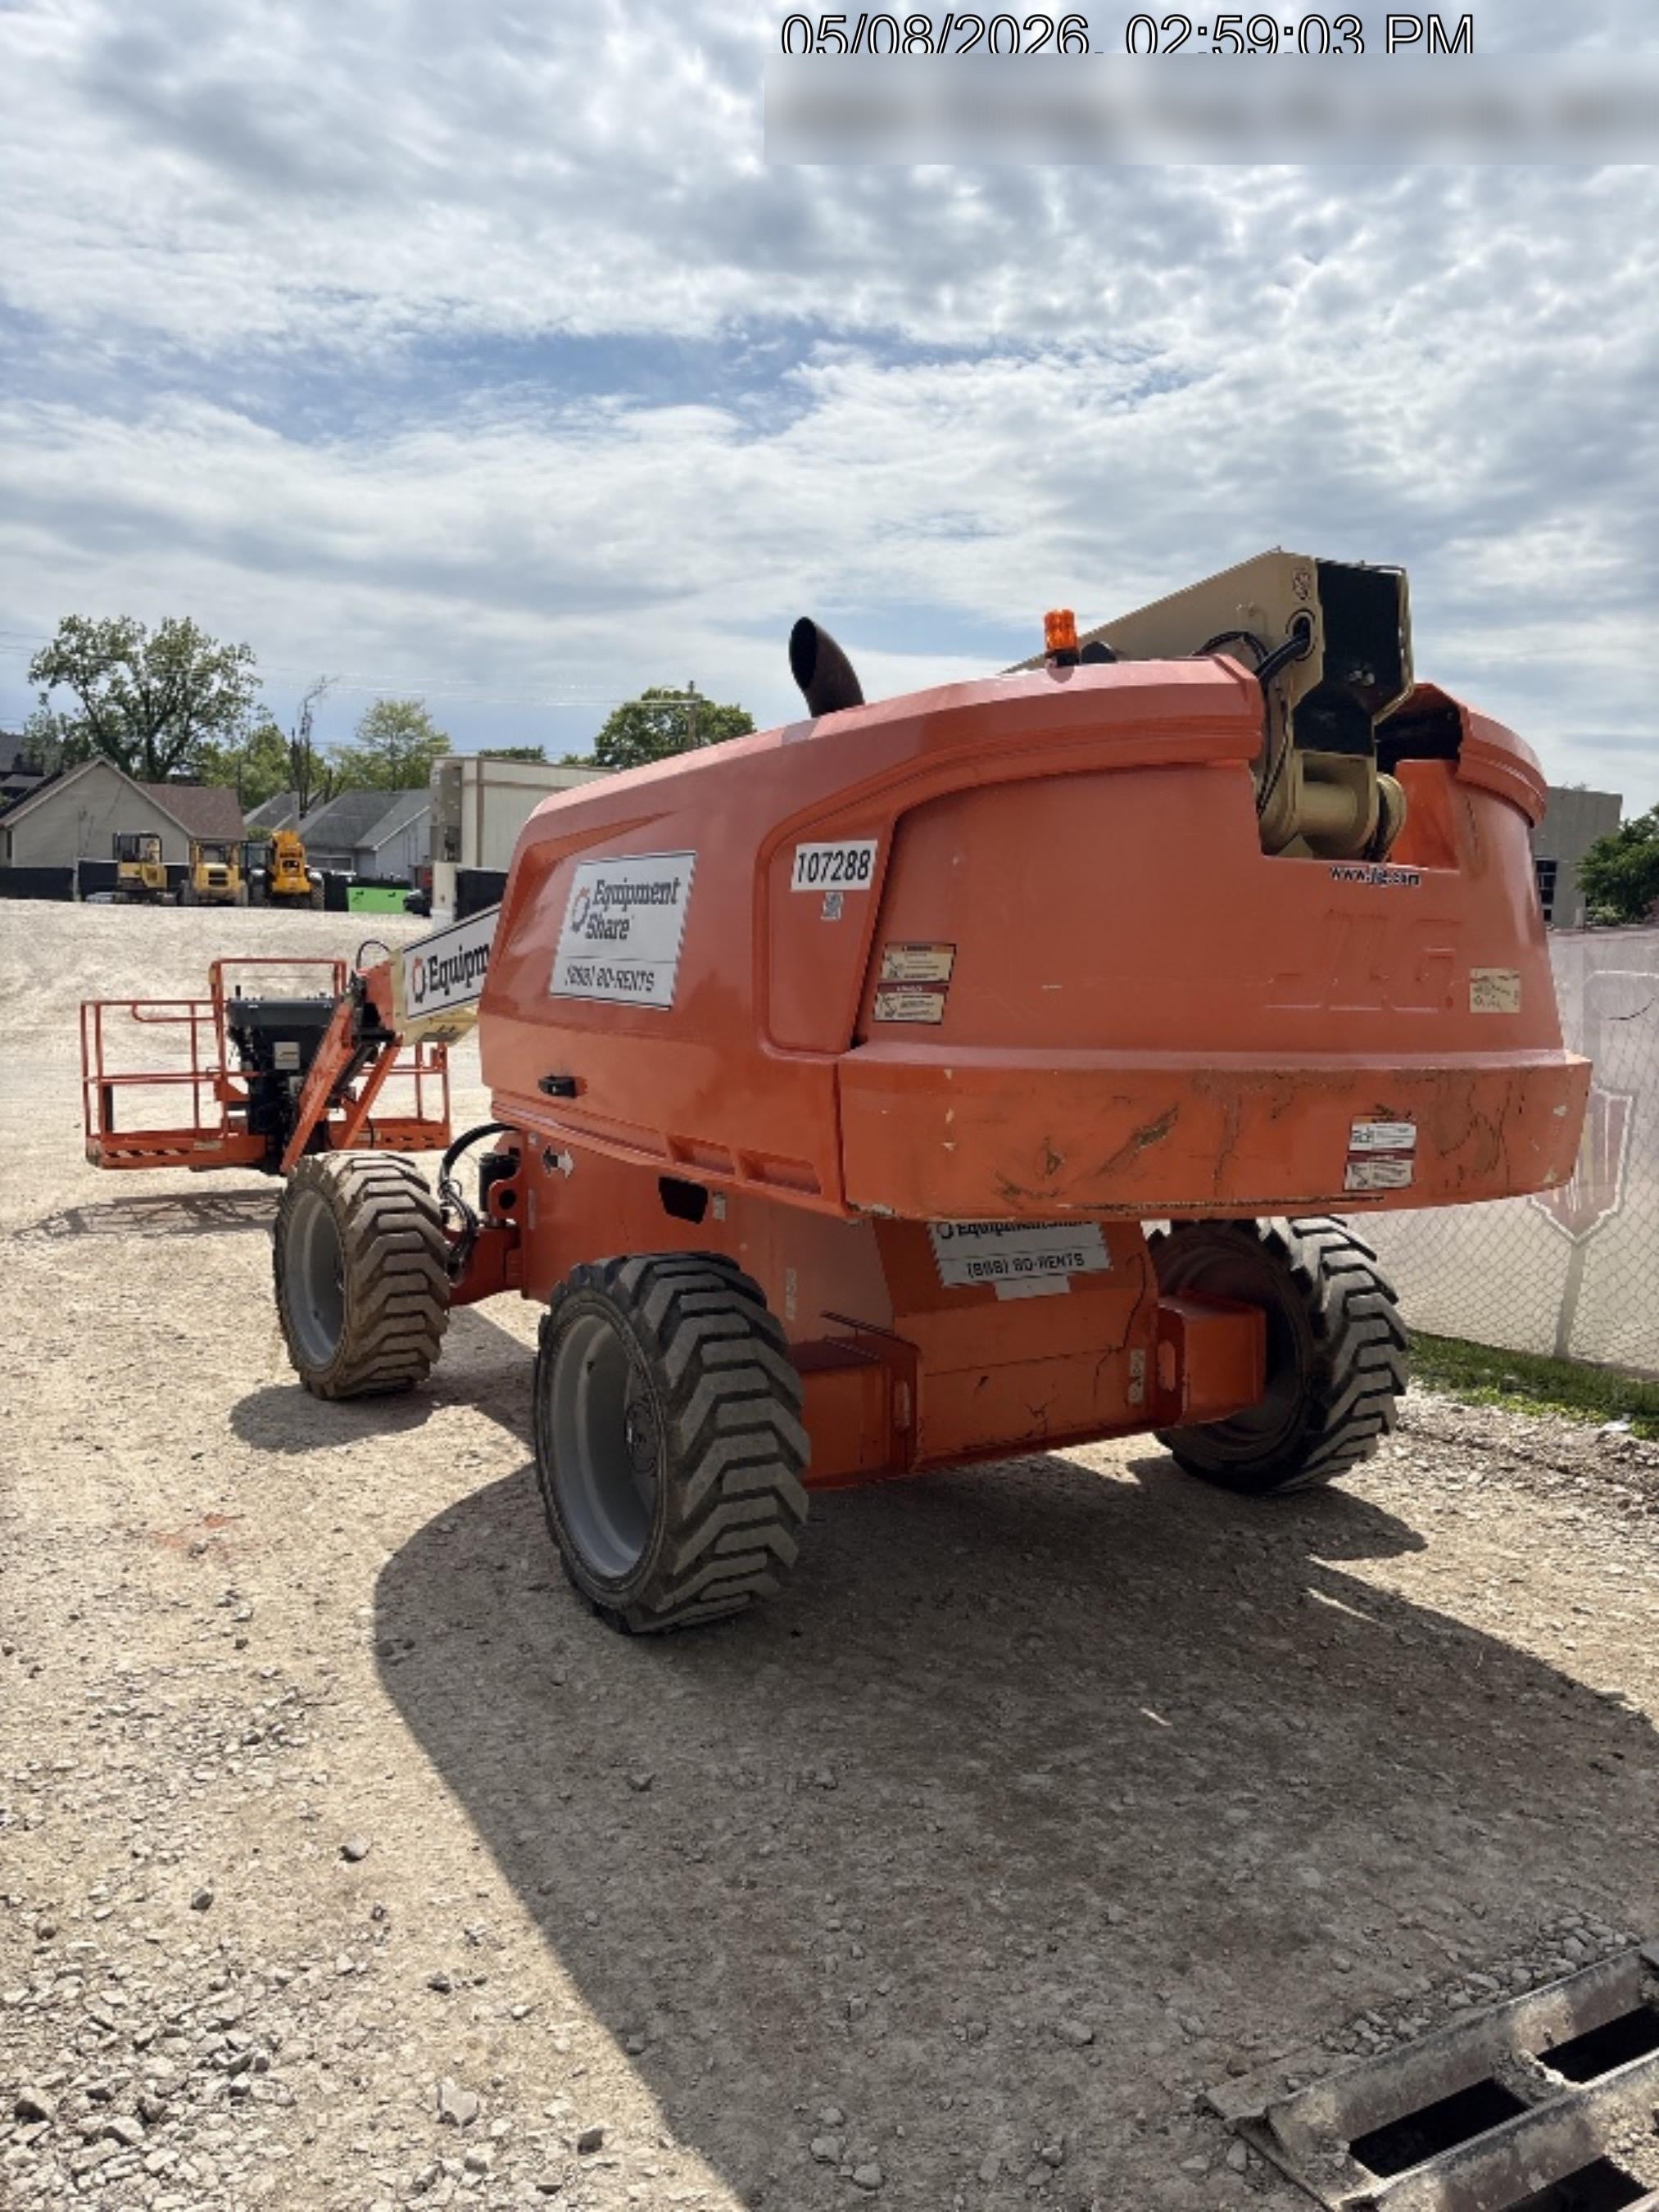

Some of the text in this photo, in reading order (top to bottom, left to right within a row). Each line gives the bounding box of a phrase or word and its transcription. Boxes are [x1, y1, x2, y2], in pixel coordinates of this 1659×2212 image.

[798, 850, 871, 882] 107288
[592, 877, 681, 912] Equipment
[585, 913, 630, 940] Share
